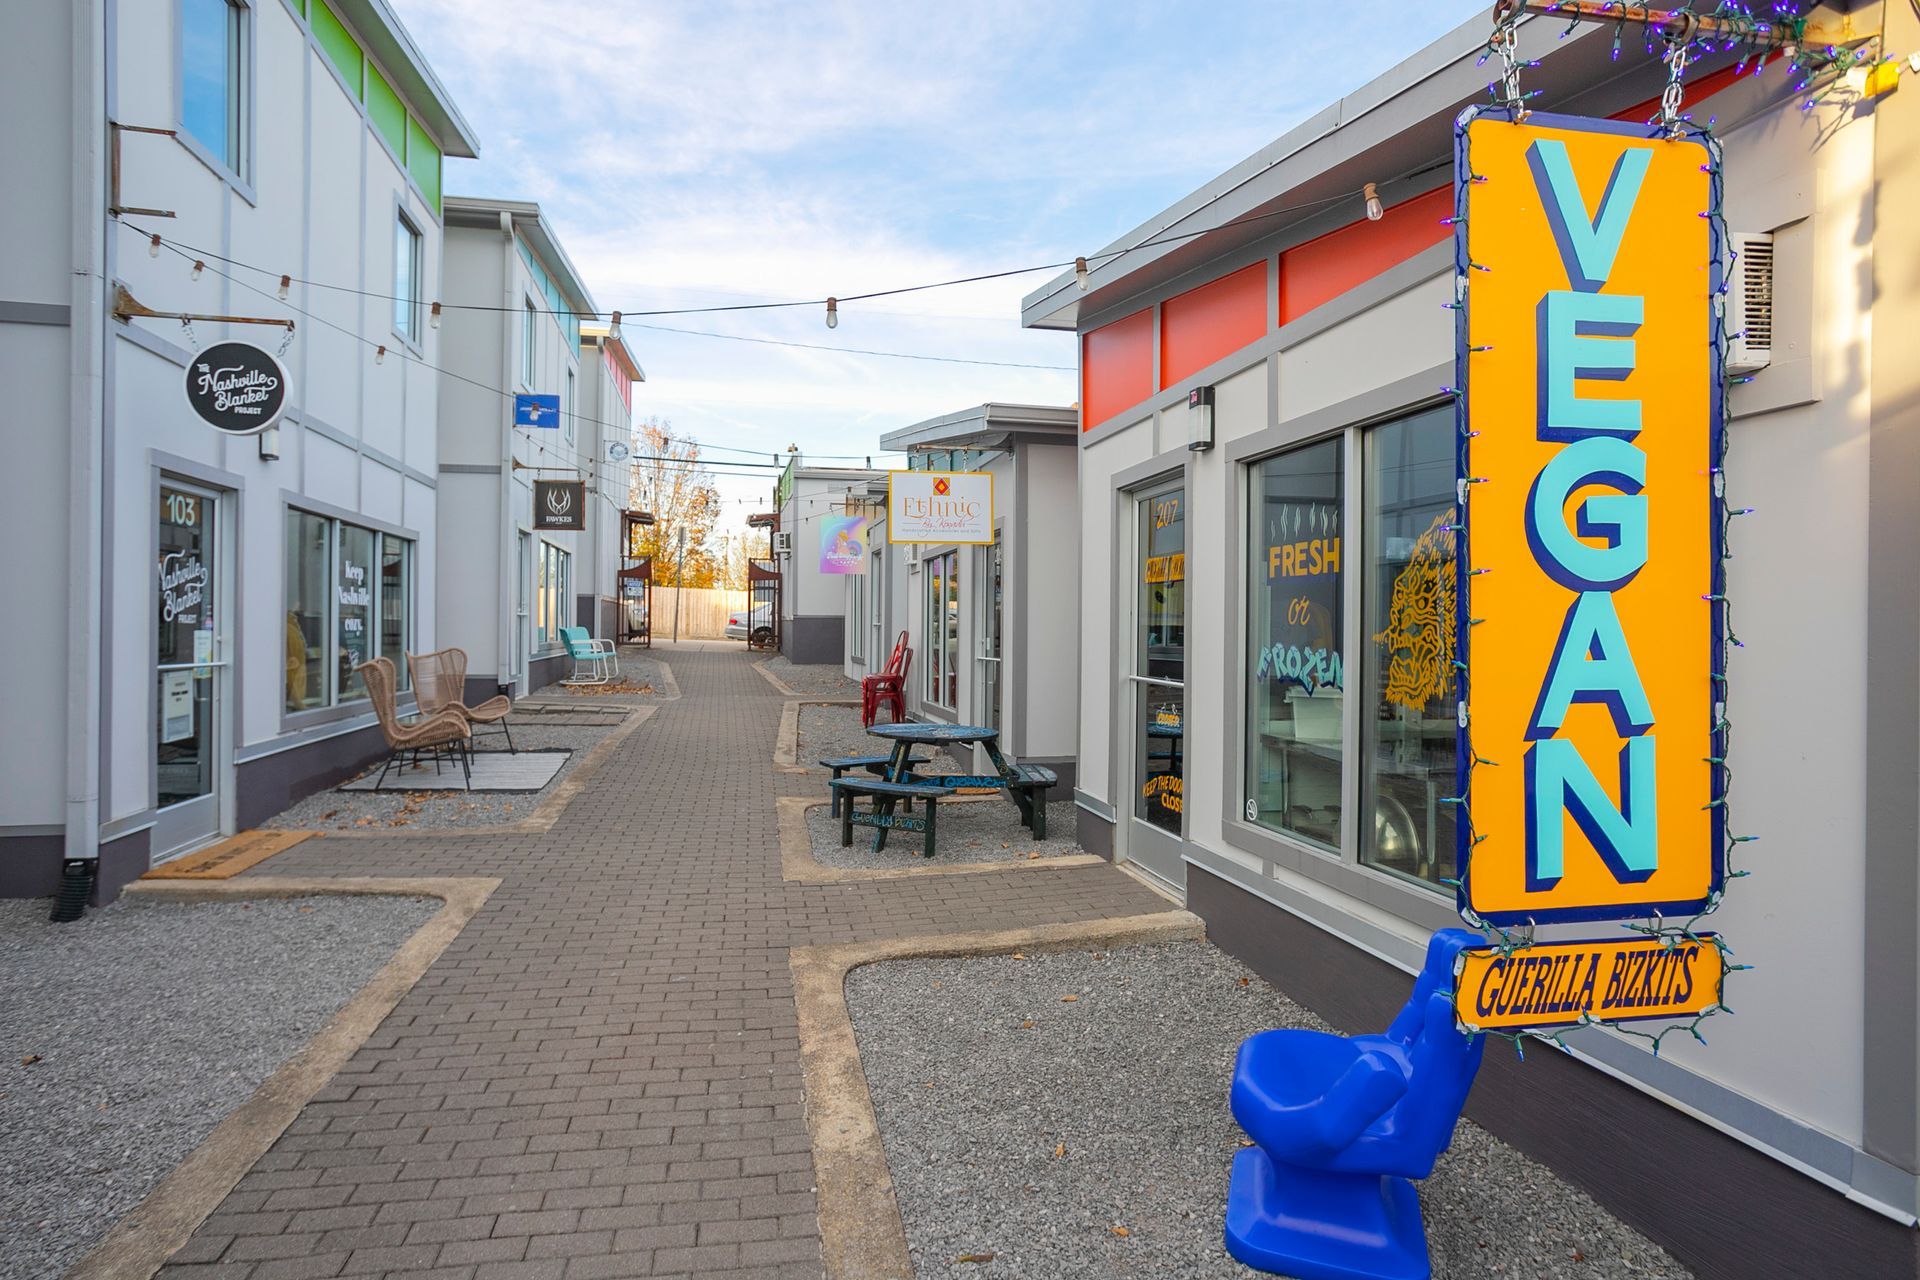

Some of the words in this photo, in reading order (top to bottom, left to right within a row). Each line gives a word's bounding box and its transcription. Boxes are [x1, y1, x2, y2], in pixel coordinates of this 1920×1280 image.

[198, 364, 268, 395] Nashville
[214, 377, 278, 411] Blanket
[234, 406, 262, 415] PROJECT
[166, 494, 196, 527] 103
[545, 515, 573, 523] FAWKES
[904, 495, 980, 522] Ethnic
[1156, 499, 1178, 529] 207
[1523, 138, 1658, 893] VEGAN
[345, 560, 364, 585] Keep
[1269, 537, 1341, 578] FRESH
[337, 586, 370, 606] Nashville
[1257, 642, 1344, 696] FROZEN
[1142, 777, 1158, 799] KEEP
[1158, 775, 1169, 792] THE
[1476, 952, 1602, 1018] GUERILLA
[1601, 945, 1700, 1010] BIZKITS
